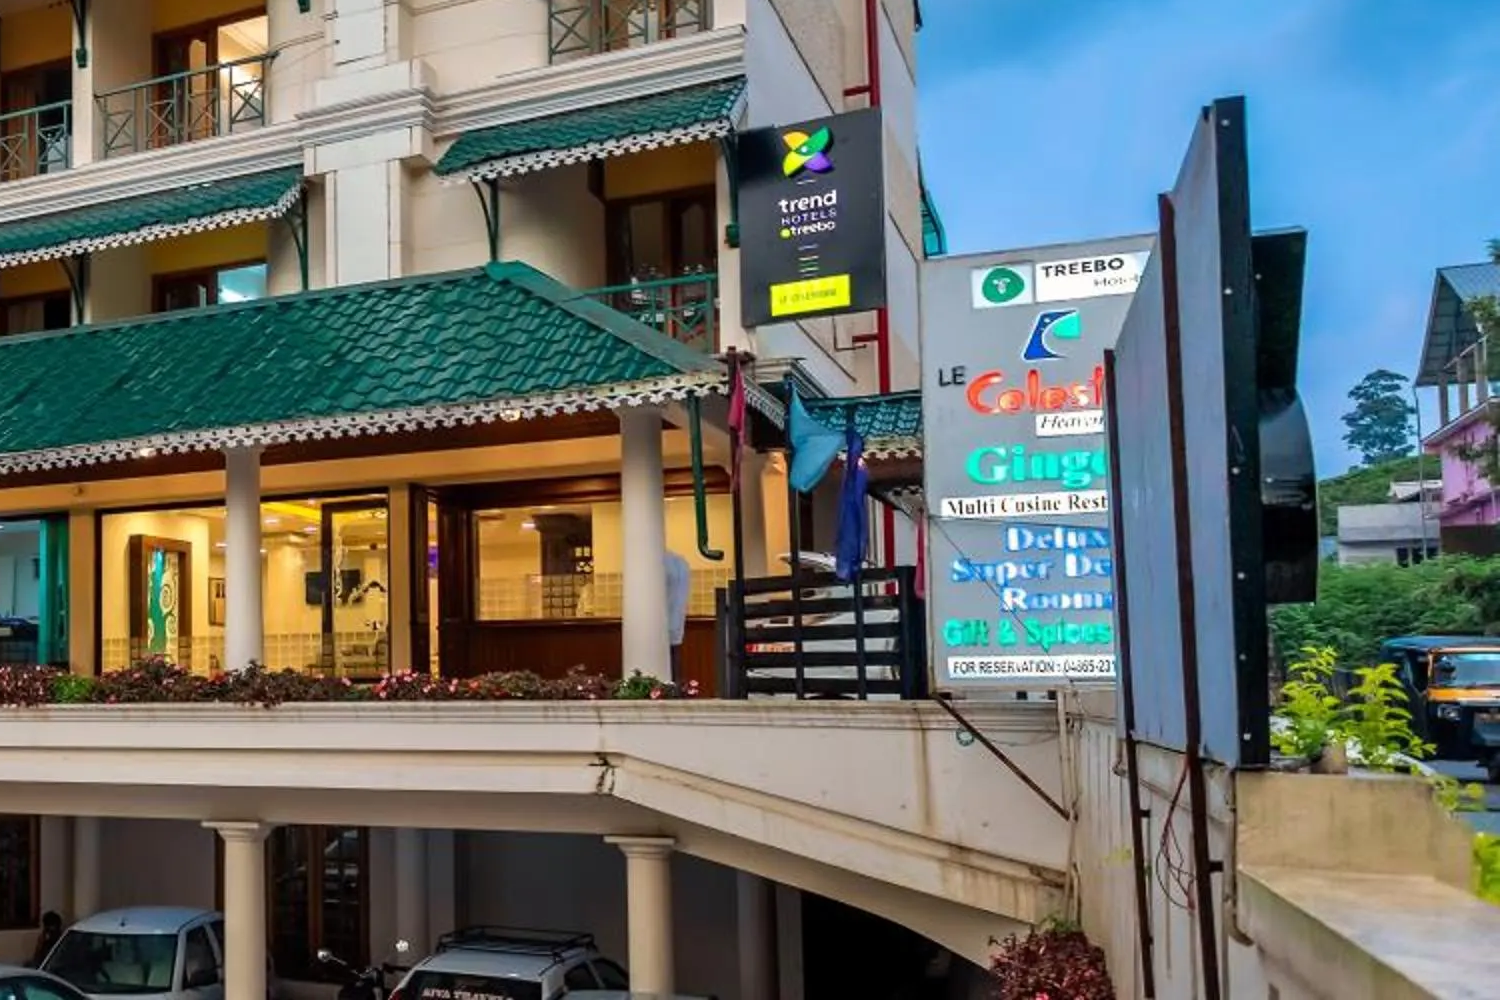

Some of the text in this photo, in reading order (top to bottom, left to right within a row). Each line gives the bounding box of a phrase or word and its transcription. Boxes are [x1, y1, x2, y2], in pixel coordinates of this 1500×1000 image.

[778, 190, 837, 213] trend
[781, 208, 837, 226] HOTELS
[790, 221, 836, 236] treebo
[1041, 257, 1124, 278] TREEBO
[938, 366, 965, 387] LE
[947, 498, 995, 515] Multi
[1001, 496, 1061, 513] Cusine
[950, 556, 1054, 586] Super
[953, 661, 976, 674] FOR
[979, 659, 1055, 674] RESERVATION
